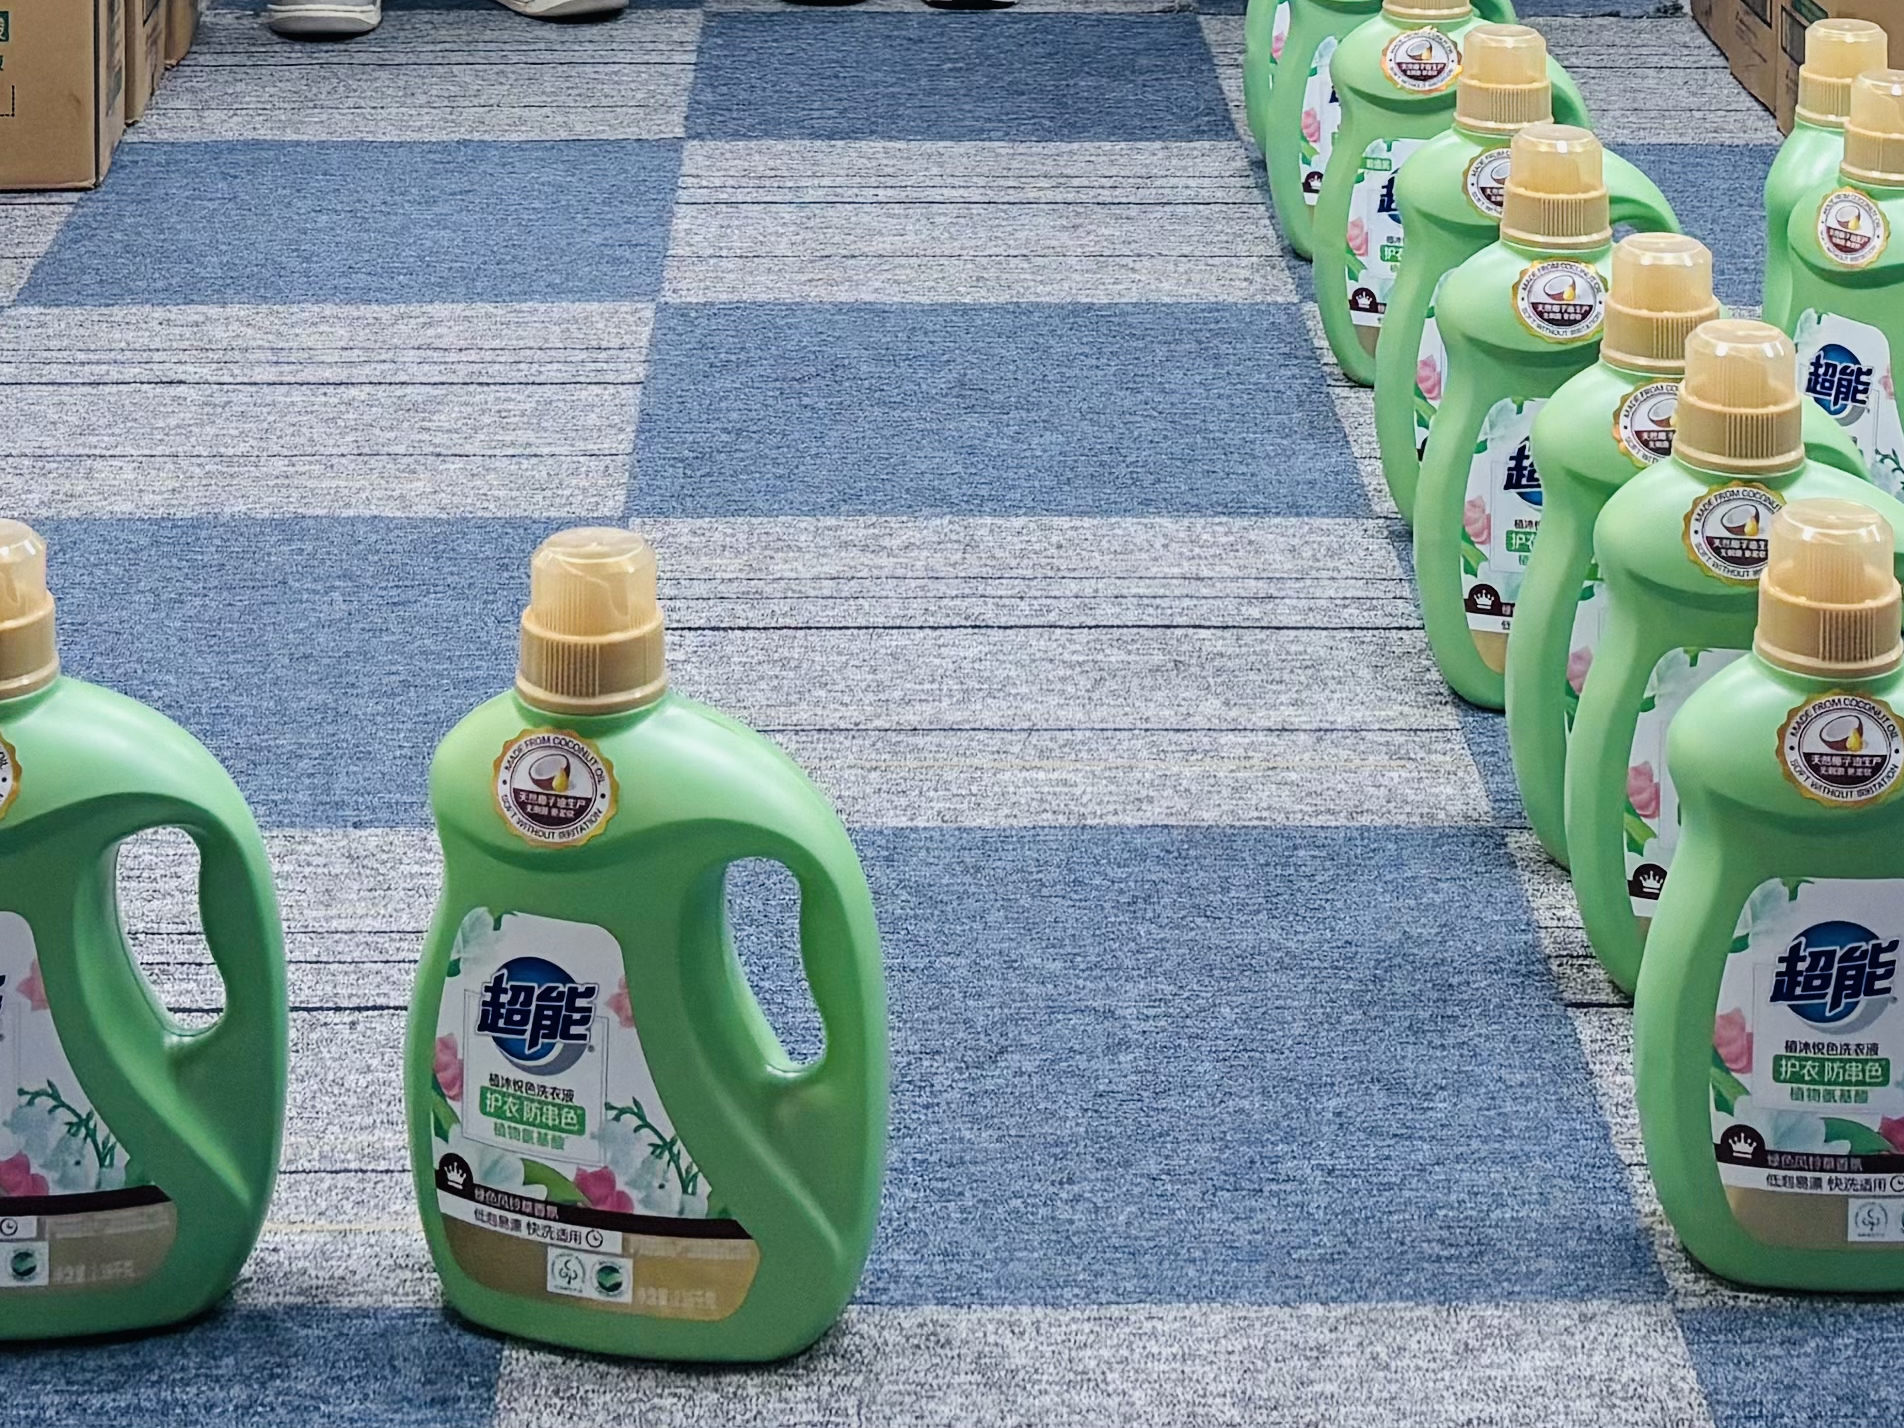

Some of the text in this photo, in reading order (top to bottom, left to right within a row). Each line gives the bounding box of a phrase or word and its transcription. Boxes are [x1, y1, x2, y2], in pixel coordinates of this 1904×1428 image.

[1790, 698, 1890, 737] MADE FROM COCONUT
[553, 737, 598, 766] COCONUT
[1810, 782, 1853, 798] WITHOUT
[1778, 1061, 1884, 1084] 护衣 防串色
[485, 1090, 580, 1130] 护衣 防串色
[1827, 1176, 1887, 1193] 快洗适用
[526, 1220, 582, 1245] 快洗适用
